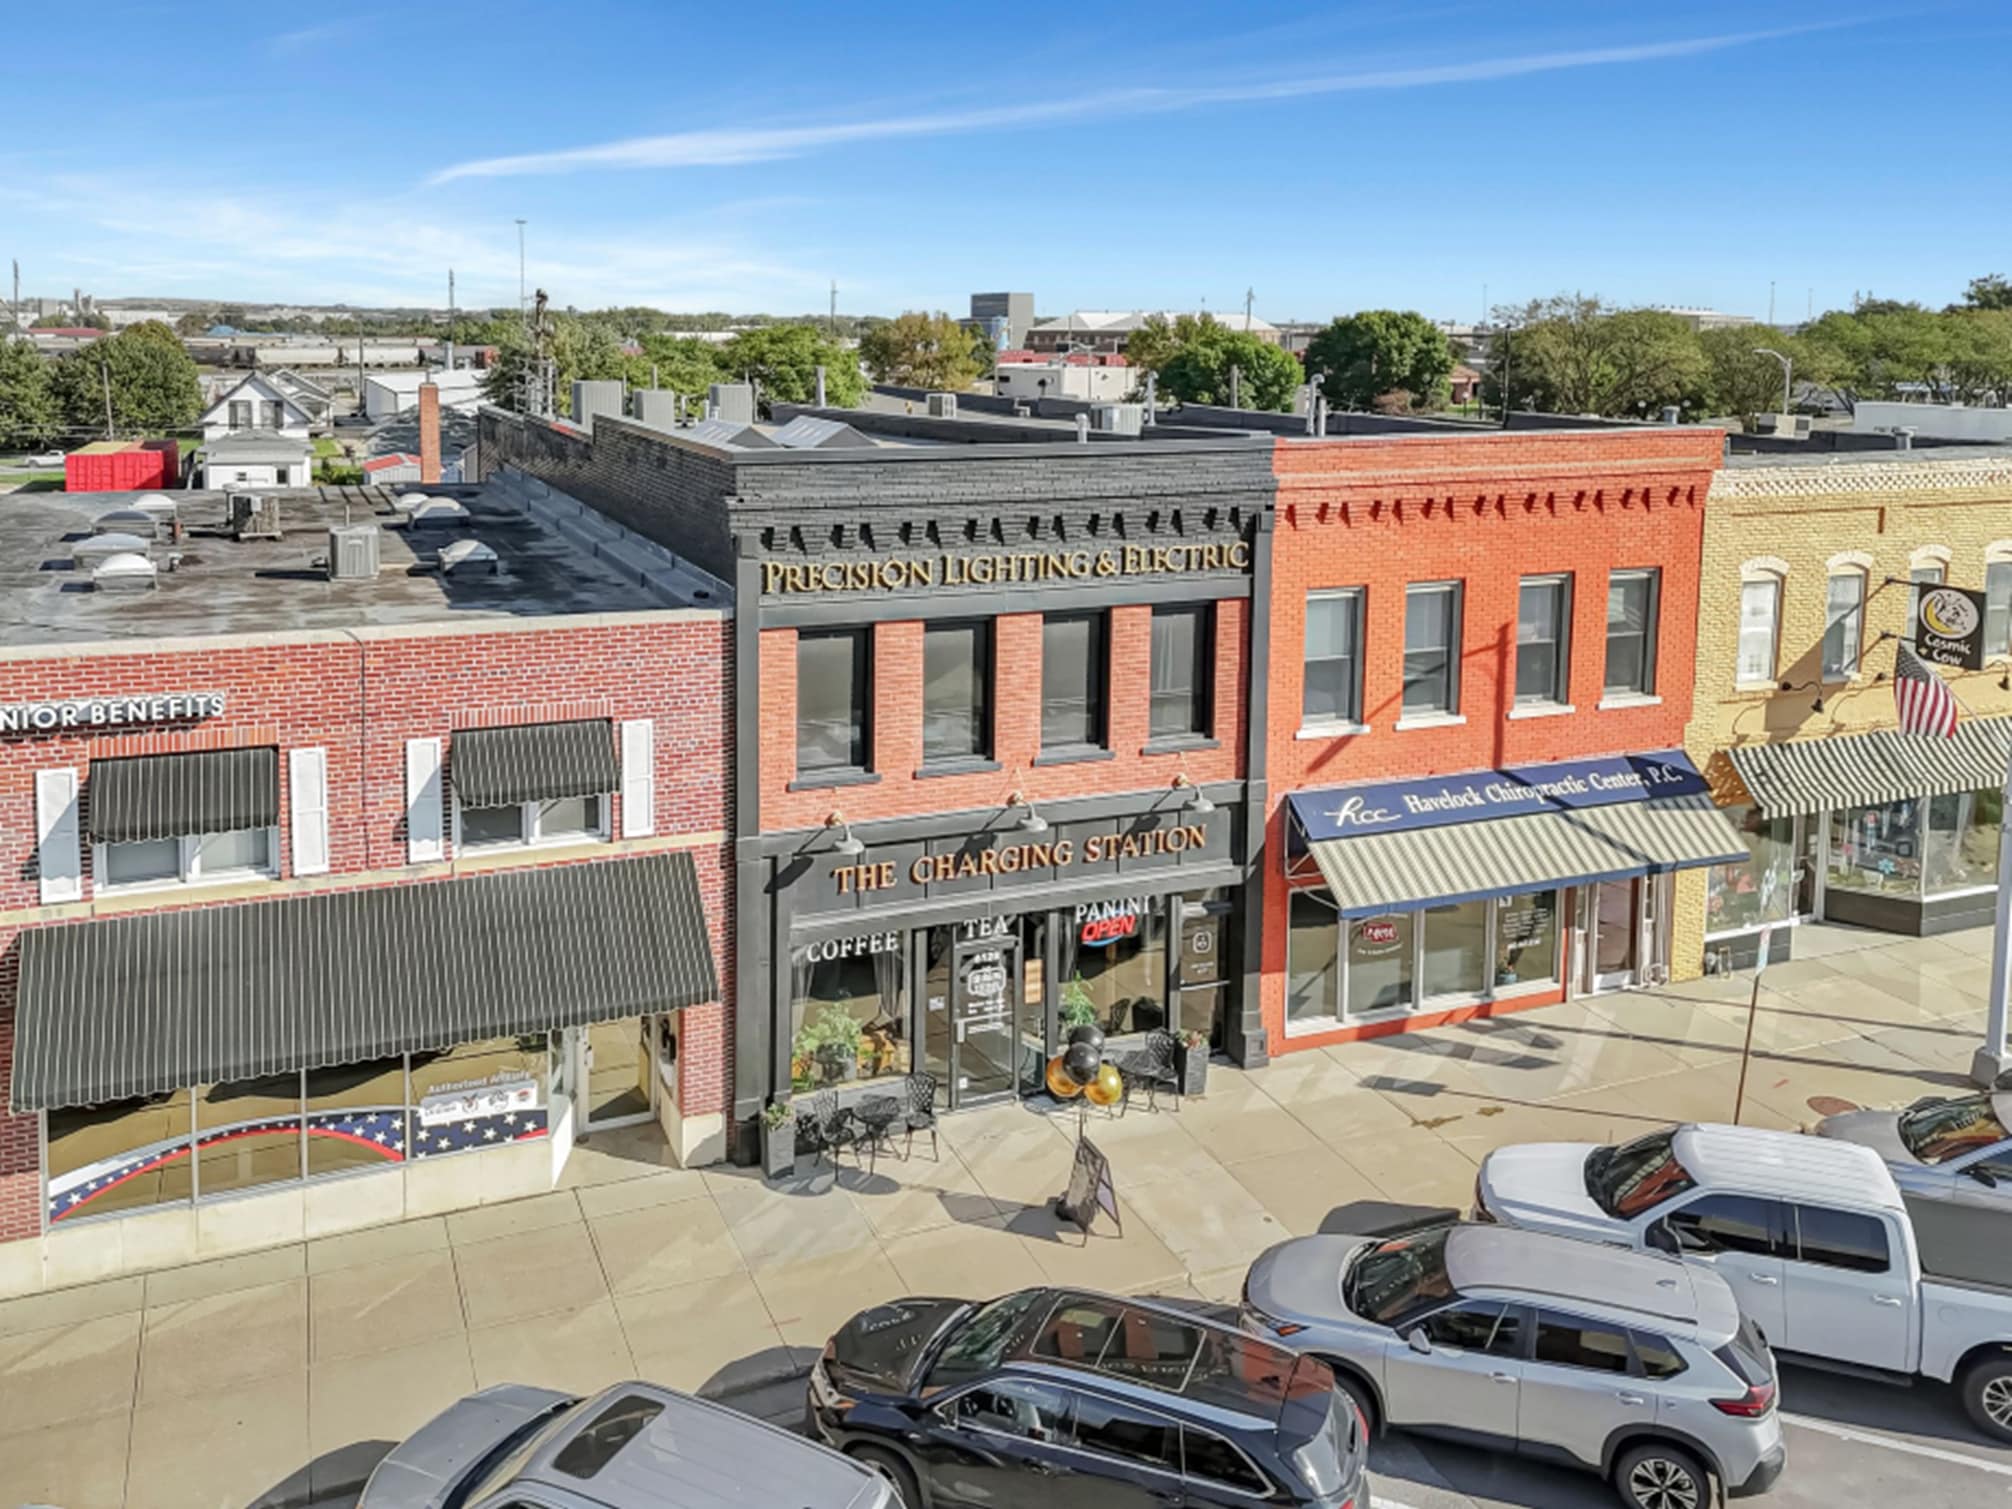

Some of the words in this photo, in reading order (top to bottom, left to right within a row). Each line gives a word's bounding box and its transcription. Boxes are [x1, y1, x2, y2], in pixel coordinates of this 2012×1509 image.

[763, 556, 934, 593] PRECISION
[942, 550, 1090, 585] LIGHTING
[1096, 549, 1118, 577] &
[1122, 541, 1249, 575] ELECTRIC
[1924, 633, 1971, 655] Cosmic
[1932, 648, 1962, 665] Cow
[91, 696, 225, 725] BENEFITS
[1403, 786, 1486, 814] Havelock
[1485, 774, 1589, 804] Chiropractic
[1589, 771, 1648, 790] Center,
[1649, 763, 1684, 783] P.C.
[832, 860, 898, 895] THE
[910, 840, 1074, 885] CHARGING
[1083, 823, 1207, 864] STATION
[1075, 894, 1150, 924] PANINI
[963, 915, 1009, 939] TEA
[1081, 915, 1137, 942] OPEN
[806, 930, 899, 963] COFFEE
